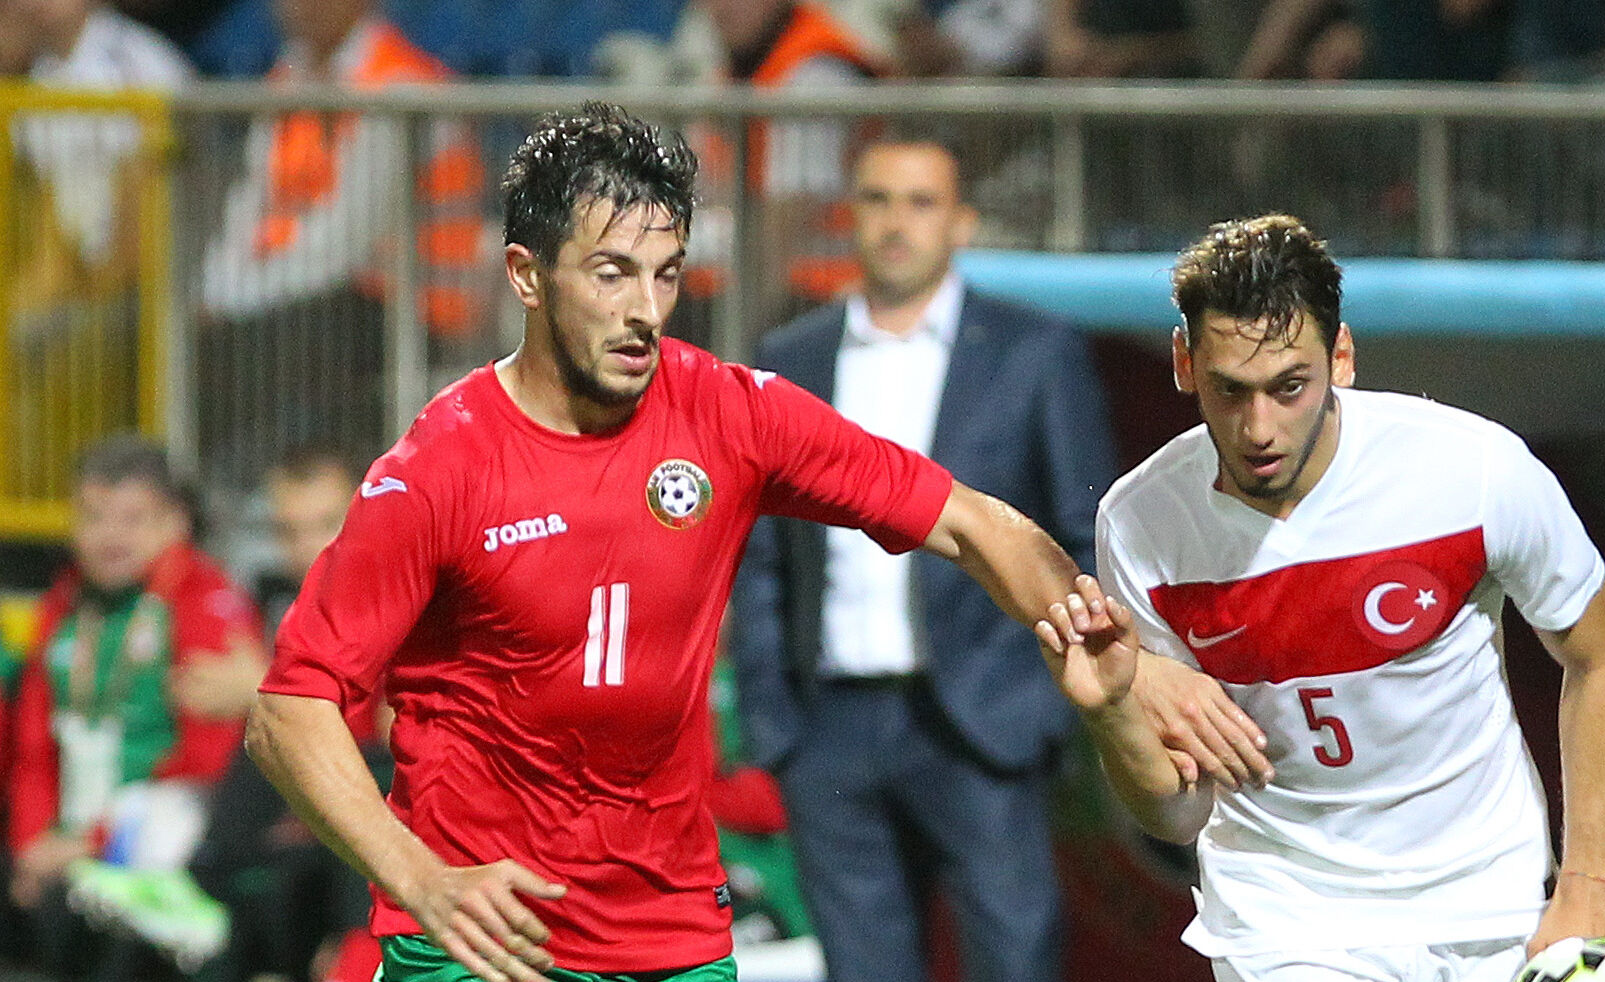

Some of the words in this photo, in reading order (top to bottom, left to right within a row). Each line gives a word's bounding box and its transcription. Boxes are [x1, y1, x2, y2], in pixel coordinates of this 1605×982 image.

[484, 513, 568, 552] Joma
[583, 582, 629, 687] 11
[1298, 687, 1354, 768] 5
